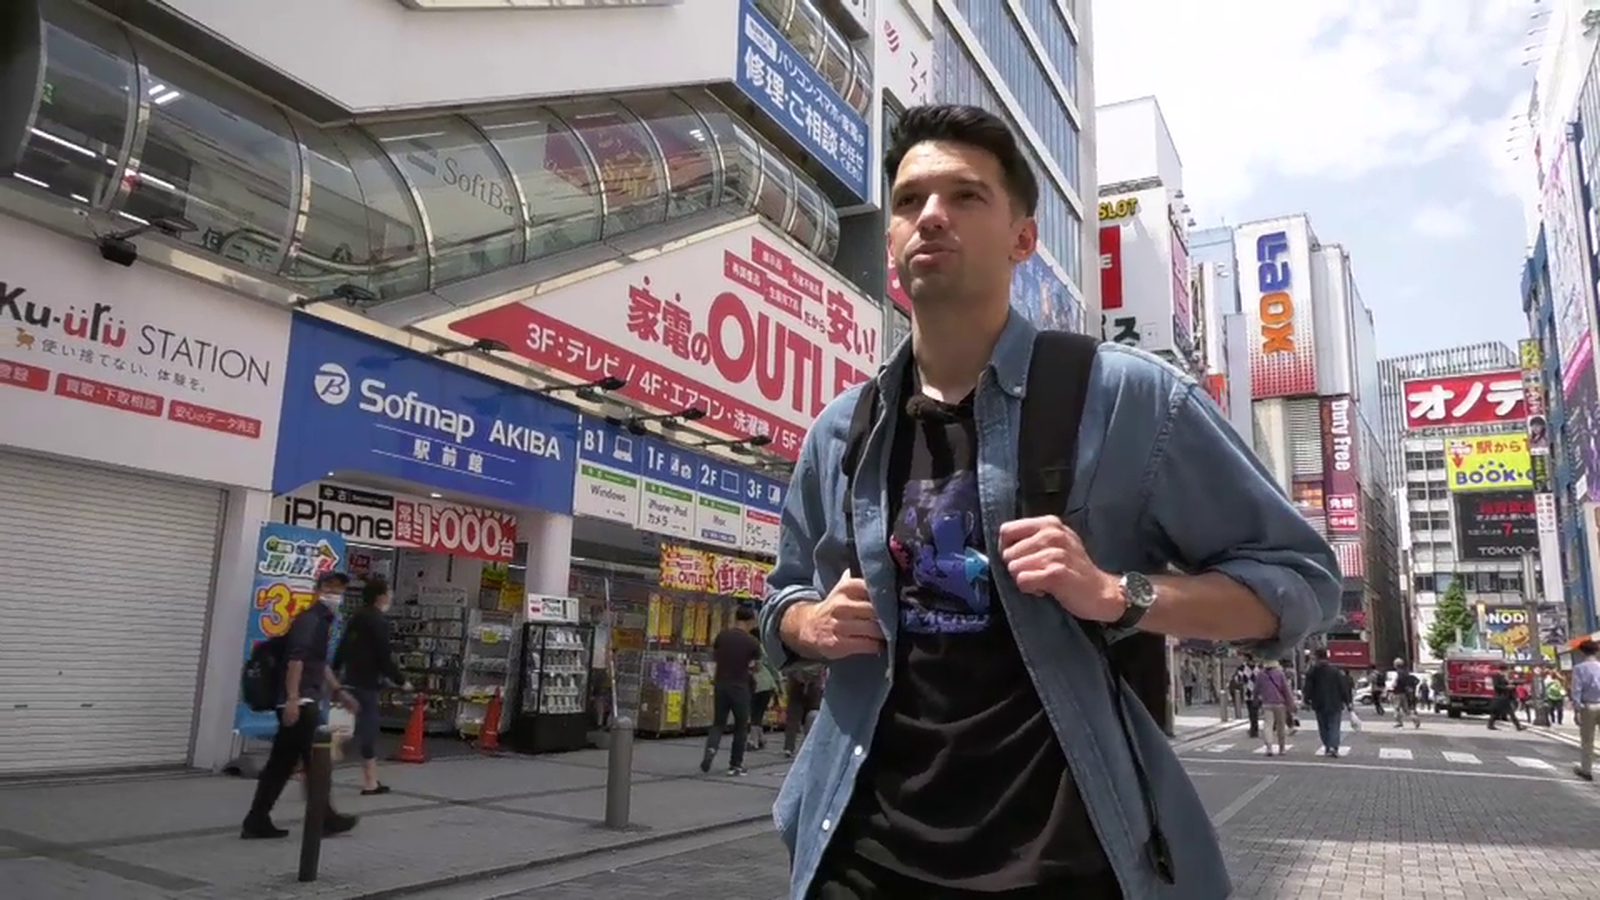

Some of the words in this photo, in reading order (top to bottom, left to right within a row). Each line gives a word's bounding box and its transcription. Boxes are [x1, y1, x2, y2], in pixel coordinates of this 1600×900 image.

[626, 276, 710, 365] 家電の
[138, 324, 270, 387] STATION
[359, 379, 475, 443] Sofmap
[489, 419, 561, 460] AKIBA
[413, 439, 484, 474] 駅前館
[648, 447, 664, 471] 1F
[701, 464, 717, 487] 2F
[747, 479, 762, 499] 3F
[285, 496, 393, 540] iPhone
